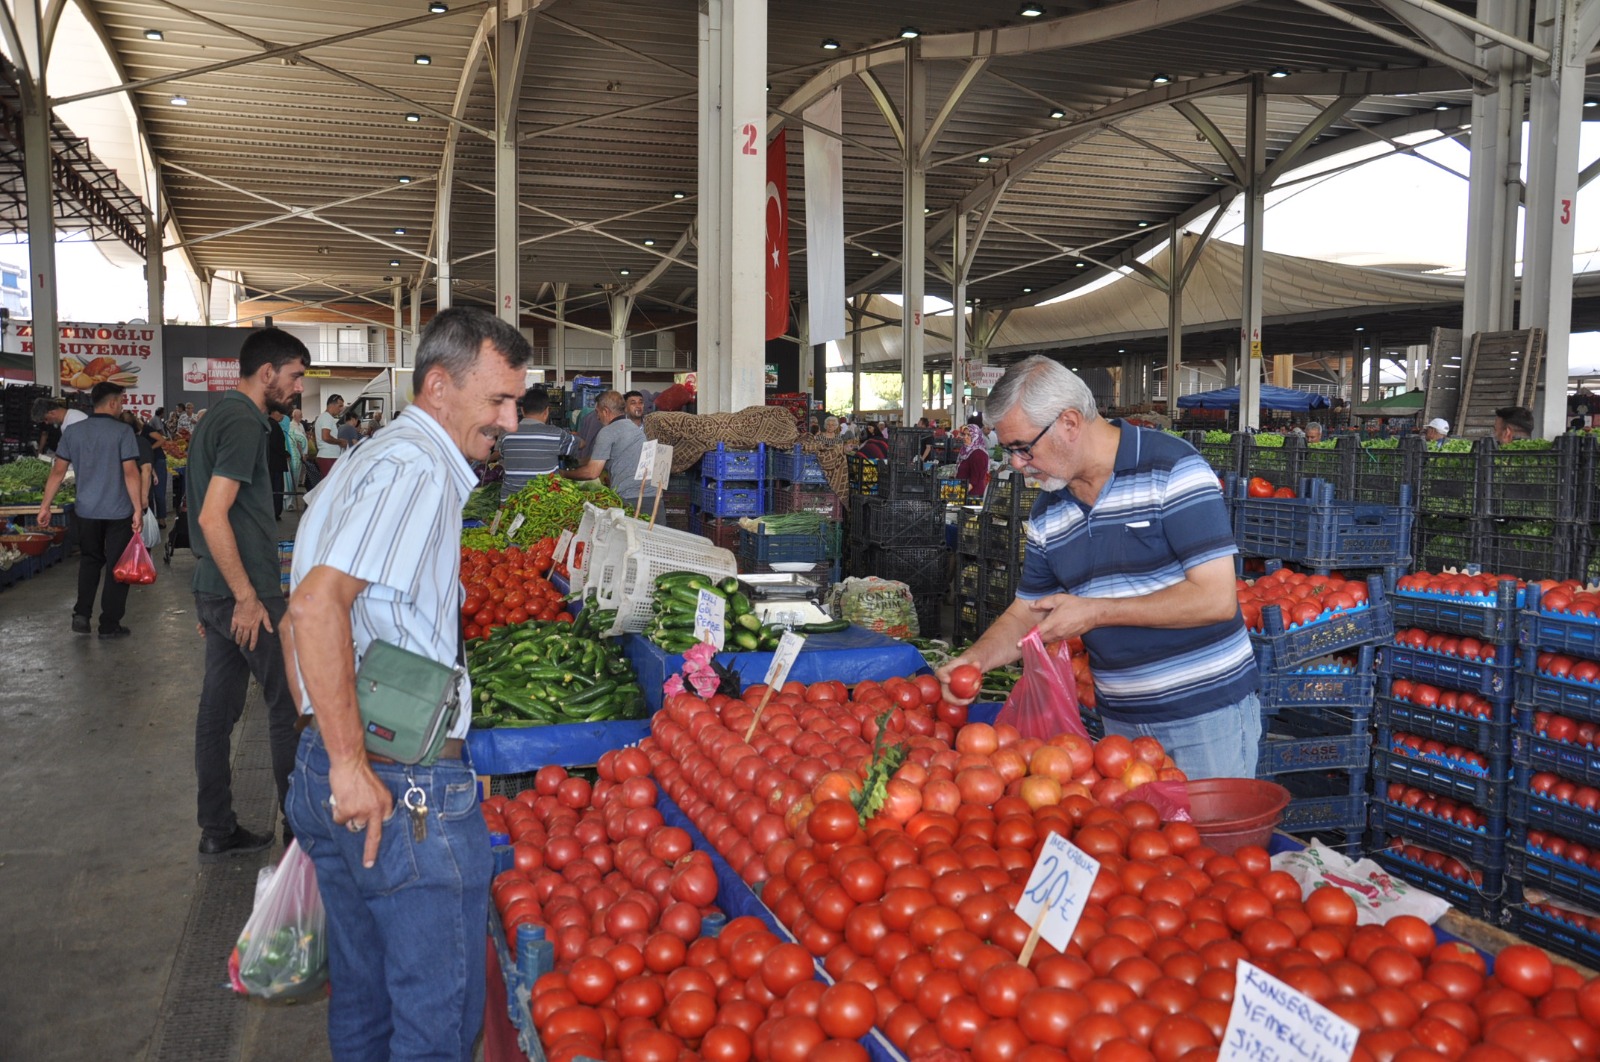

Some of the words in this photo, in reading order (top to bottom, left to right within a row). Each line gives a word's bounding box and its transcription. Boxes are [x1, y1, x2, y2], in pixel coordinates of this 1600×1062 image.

[742, 123, 757, 155] 2
[1560, 199, 1571, 225] 3
[38, 273, 44, 289] 1
[504, 295, 512, 309] 2
[914, 312, 921, 326] 3
[16, 324, 155, 341] ZTİNOĞLU
[1253, 329, 1259, 340] 4
[21, 341, 152, 359] KRUYEMİŞ
[212, 359, 240, 369] KARAGÖ
[208, 369, 240, 379] TAVUKÇUL
